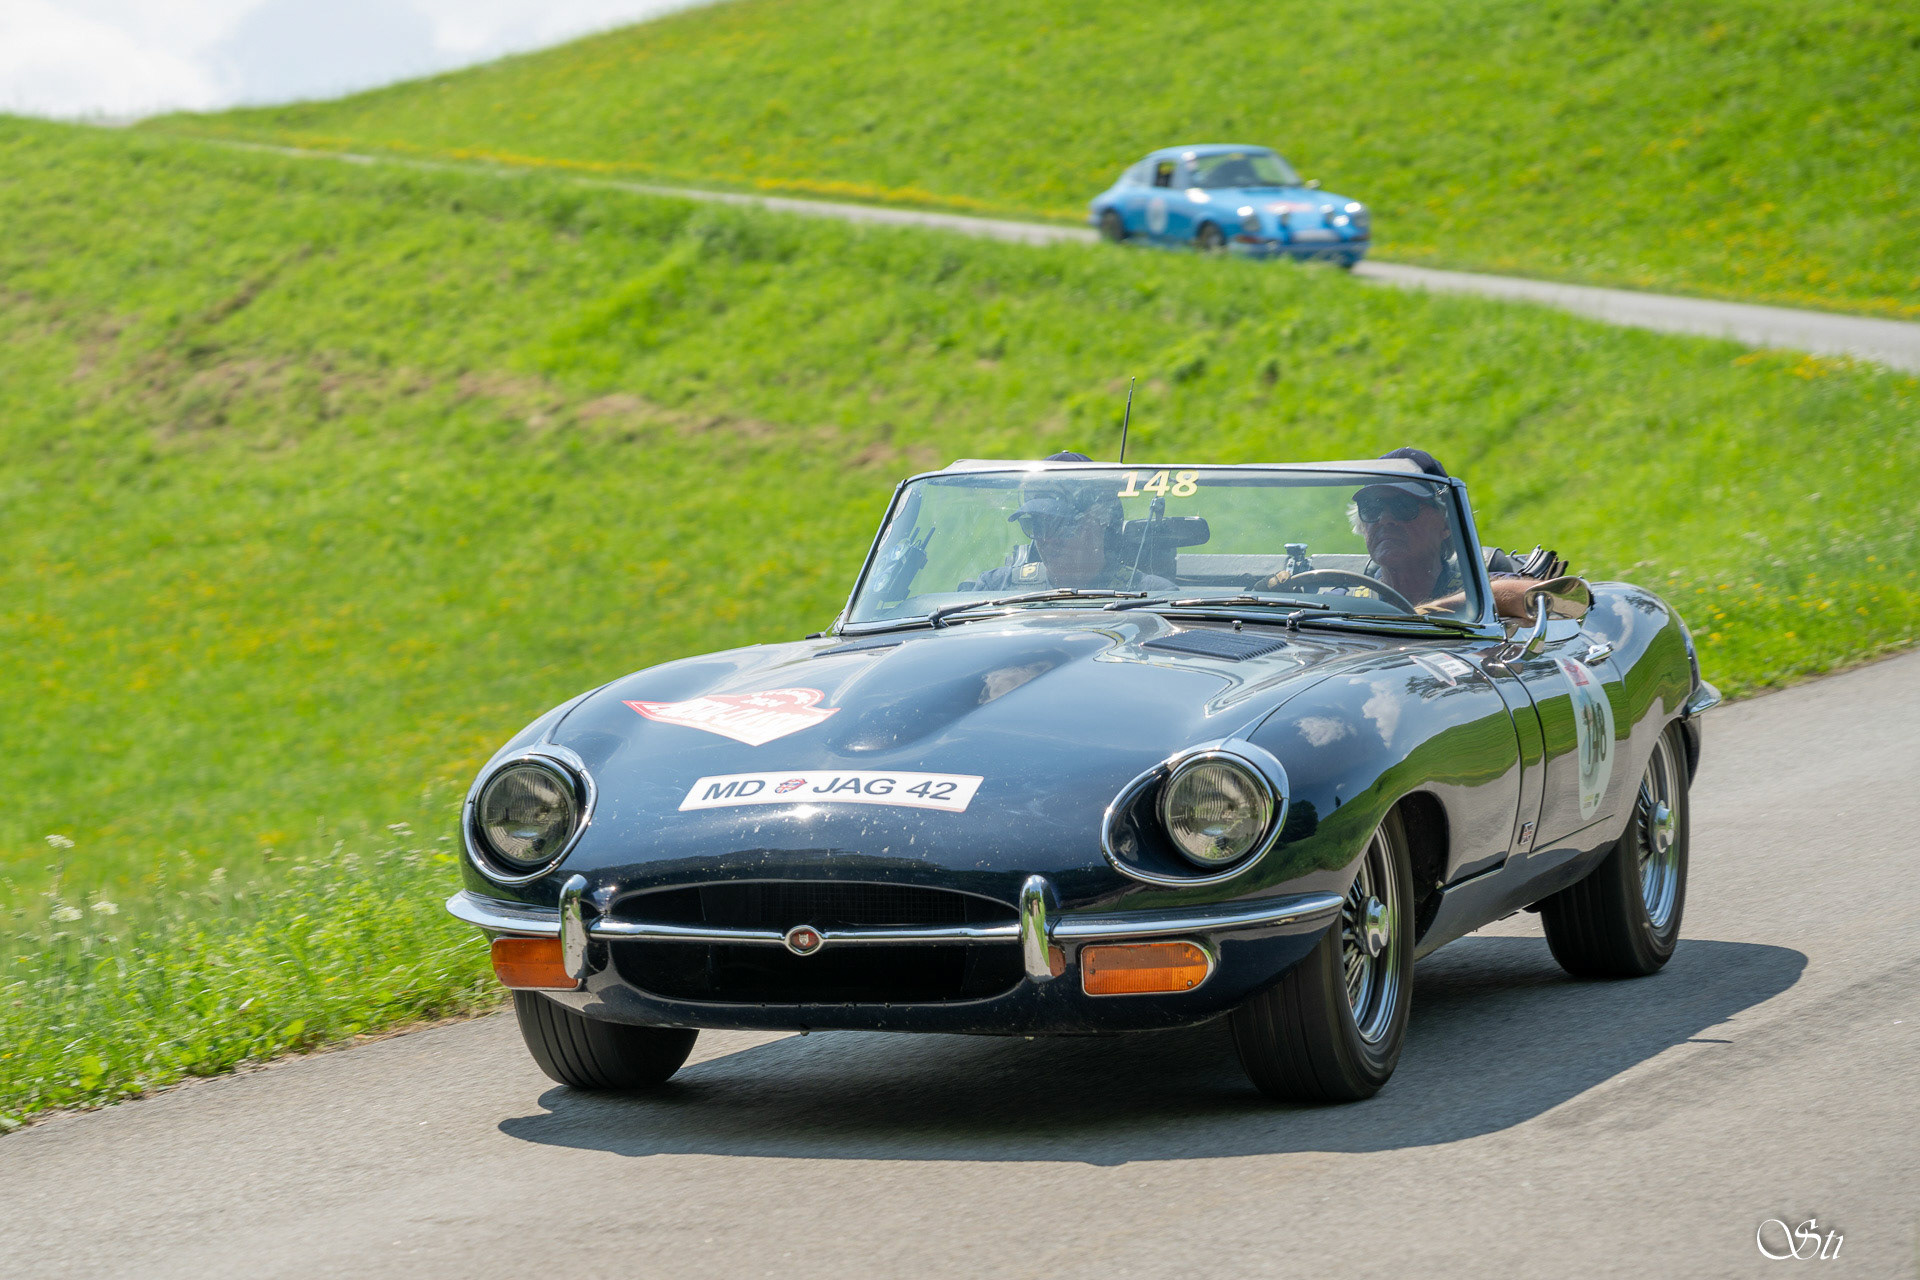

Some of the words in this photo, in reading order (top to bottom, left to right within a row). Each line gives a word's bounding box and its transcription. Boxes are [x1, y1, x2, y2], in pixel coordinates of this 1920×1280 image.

[1117, 469, 1199, 498] 148
[702, 779, 766, 801] MD
[813, 777, 897, 795] JAG
[906, 780, 958, 801] 42
